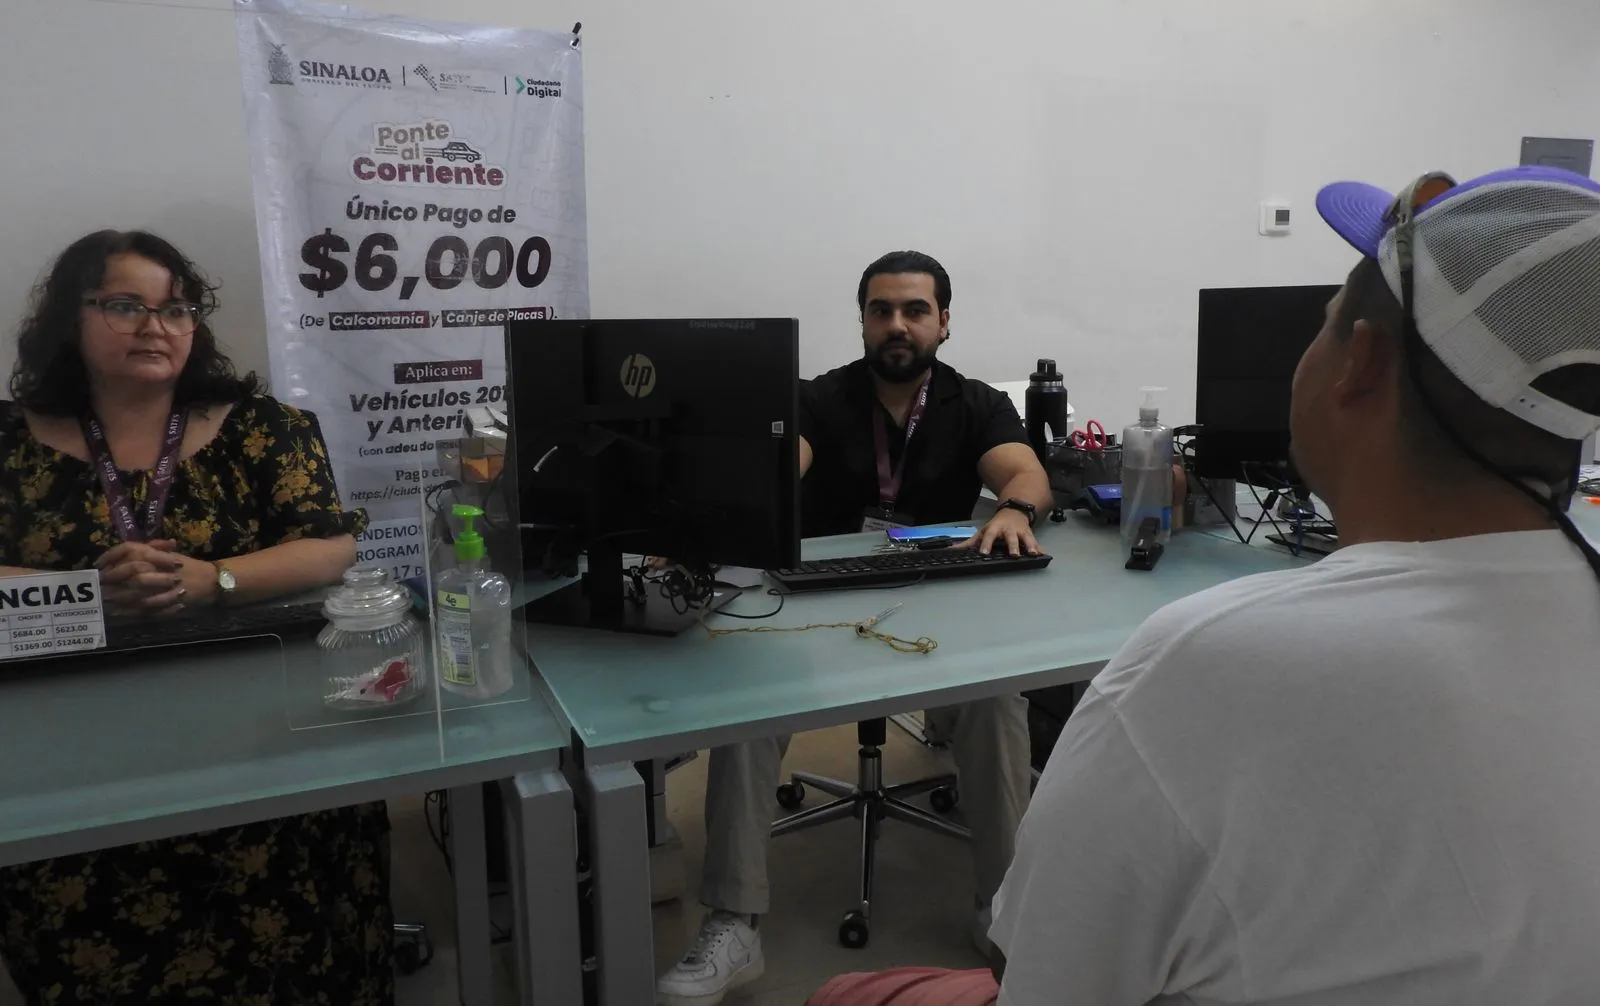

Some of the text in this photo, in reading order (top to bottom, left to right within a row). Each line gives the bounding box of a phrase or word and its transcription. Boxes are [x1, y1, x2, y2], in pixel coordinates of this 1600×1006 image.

[299, 60, 391, 83] SINALOA
[526, 78, 561, 87] Ciudadano
[527, 86, 562, 99] Digital
[377, 122, 450, 146] Ponte
[401, 143, 419, 161] al
[353, 156, 504, 186] Corriente
[346, 195, 517, 229] Único Pago de
[298, 227, 552, 300] $6,000
[300, 313, 324, 329] (De
[332, 311, 425, 327] Calcomanía
[431, 313, 440, 328] y
[446, 311, 486, 326] Canje
[488, 311, 505, 323] de
[507, 309, 544, 321] Placas
[405, 364, 473, 381] Aplica en:
[623, 353, 653, 399] hp
[349, 387, 471, 412] Vehículos
[366, 418, 383, 441] y
[395, 468, 429, 482] Pago
[393, 565, 410, 579] 17
[0, 582, 95, 609] NCIAS
